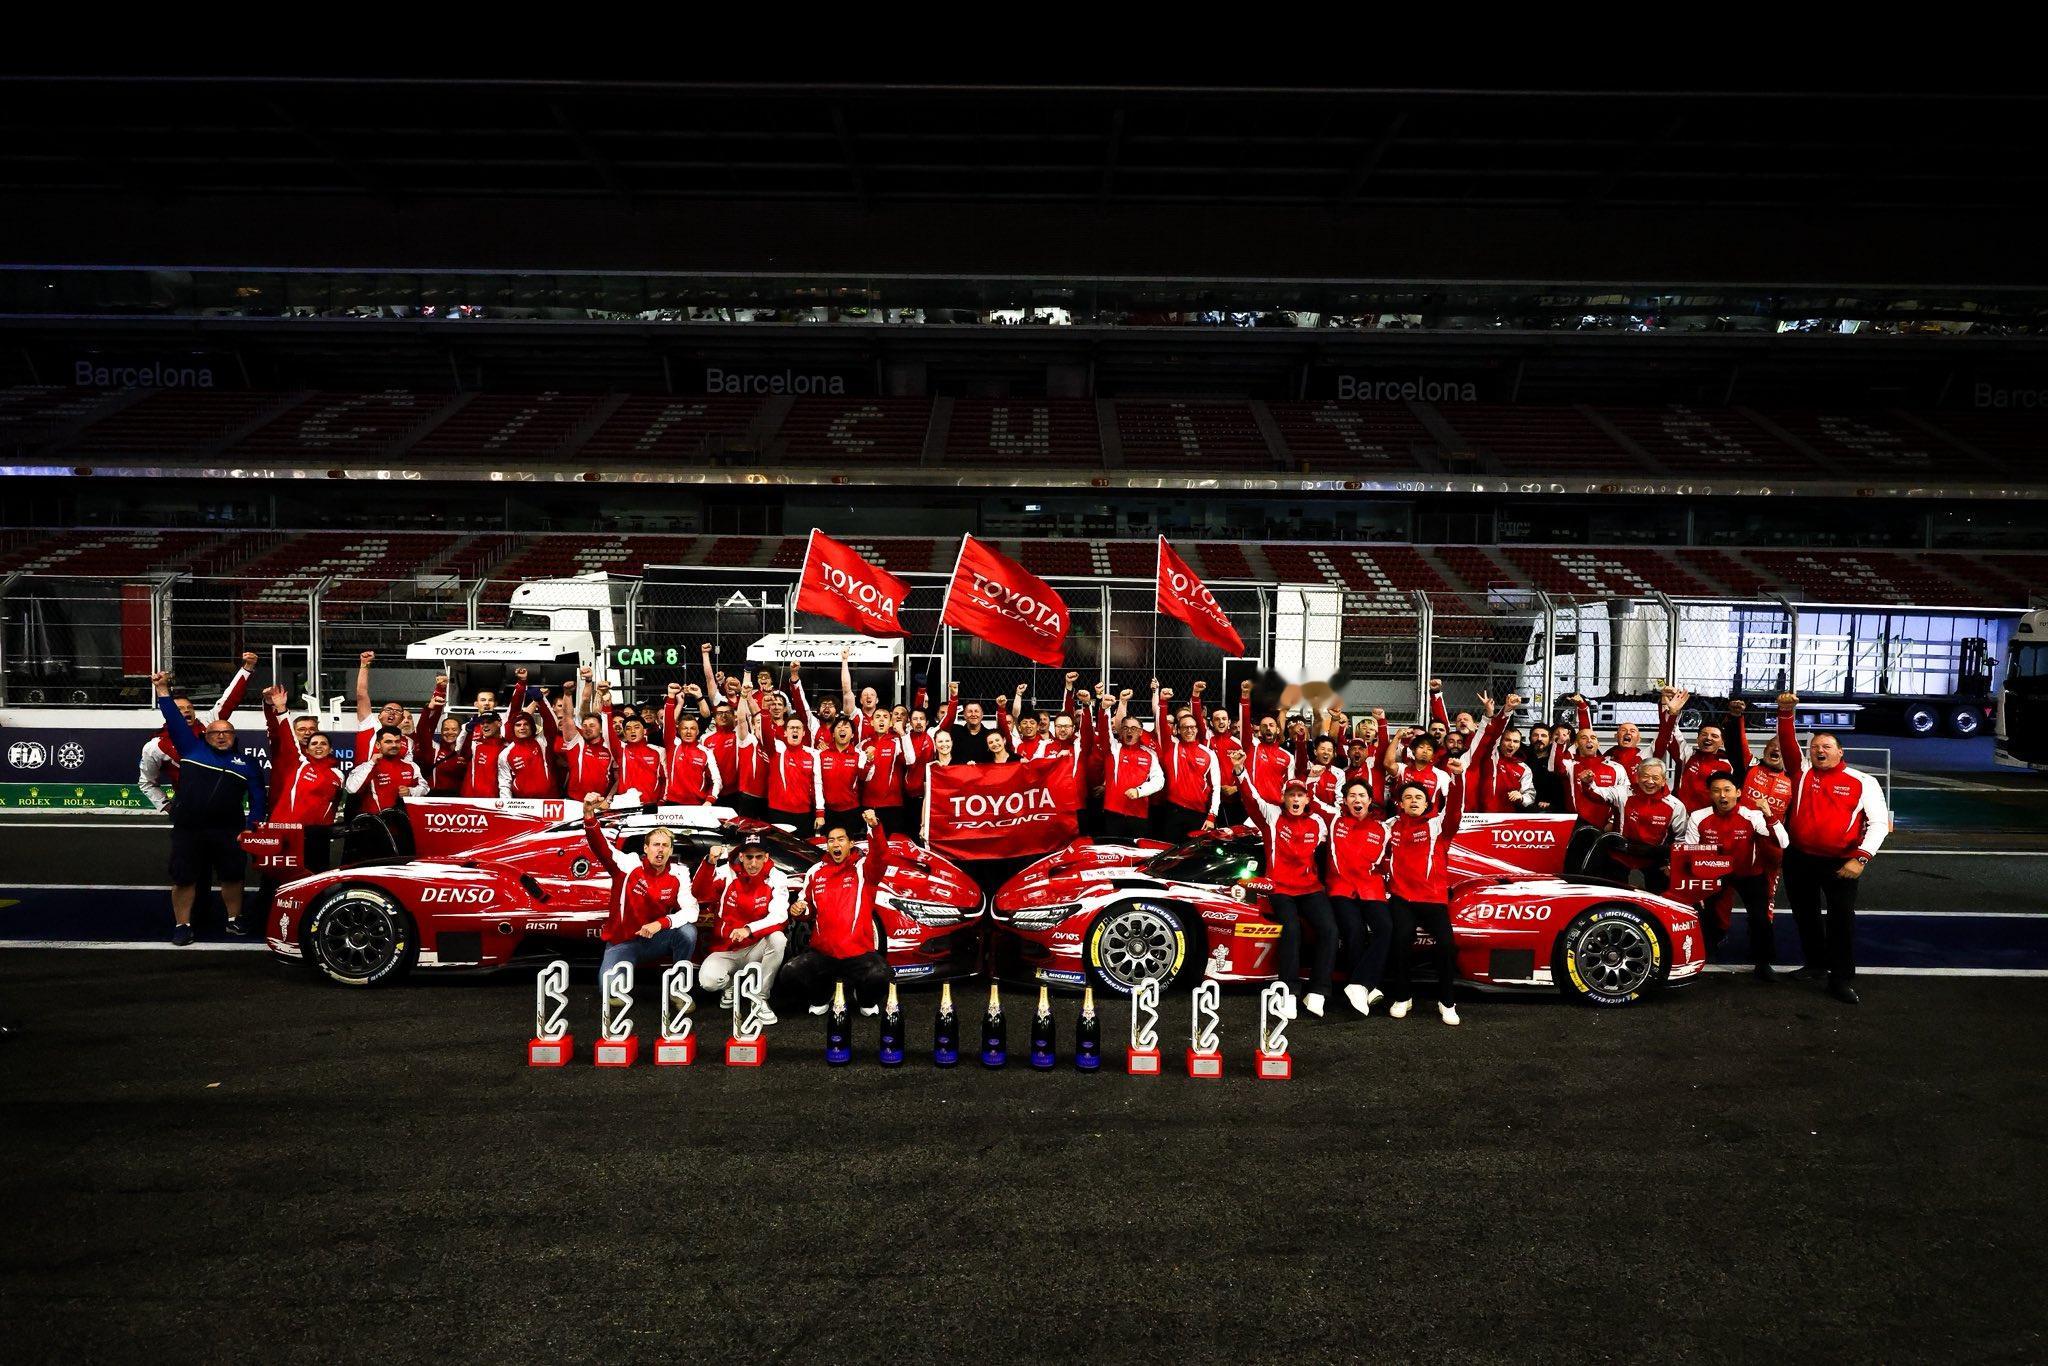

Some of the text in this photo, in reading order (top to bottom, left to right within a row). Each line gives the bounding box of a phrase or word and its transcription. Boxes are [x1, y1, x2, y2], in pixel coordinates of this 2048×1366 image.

[74, 360, 214, 387] Barcelona
[706, 367, 846, 394] Barcelona
[1338, 374, 1478, 401] Barcelona
[821, 561, 894, 618] TOYOTA
[973, 572, 1061, 633] TOYOTA
[967, 593, 1058, 637] RACING
[435, 647, 475, 656] TOYOTA
[617, 648, 678, 665] CAR 8
[775, 650, 815, 658] TOYOTA
[18, 798, 50, 806] ROLEX
[63, 798, 95, 806] ROLEX
[109, 799, 141, 807] ROLEX
[949, 787, 1056, 817] TOYOTA
[1747, 786, 1786, 808] TOYOTA
[544, 804, 563, 818] HY
[425, 813, 489, 827] TOYOTA
[949, 813, 1057, 829] RACING
[1491, 830, 1555, 843] TOYOTA
[258, 855, 298, 867] JFE
[1247, 882, 1273, 890] DENSO
[1675, 879, 1714, 891] JFE
[420, 887, 495, 903] DENSO
[1146, 905, 1179, 929] MICHELIN
[1202, 911, 1239, 920] RAYS
[1476, 903, 1552, 921] DENSO
[1604, 911, 1641, 923] MICHELIN
[1242, 926, 1280, 935] DHL
[1672, 920, 1691, 932] Mobil
[1253, 942, 1272, 969] 7
[1048, 972, 1081, 980] MICHELIN
